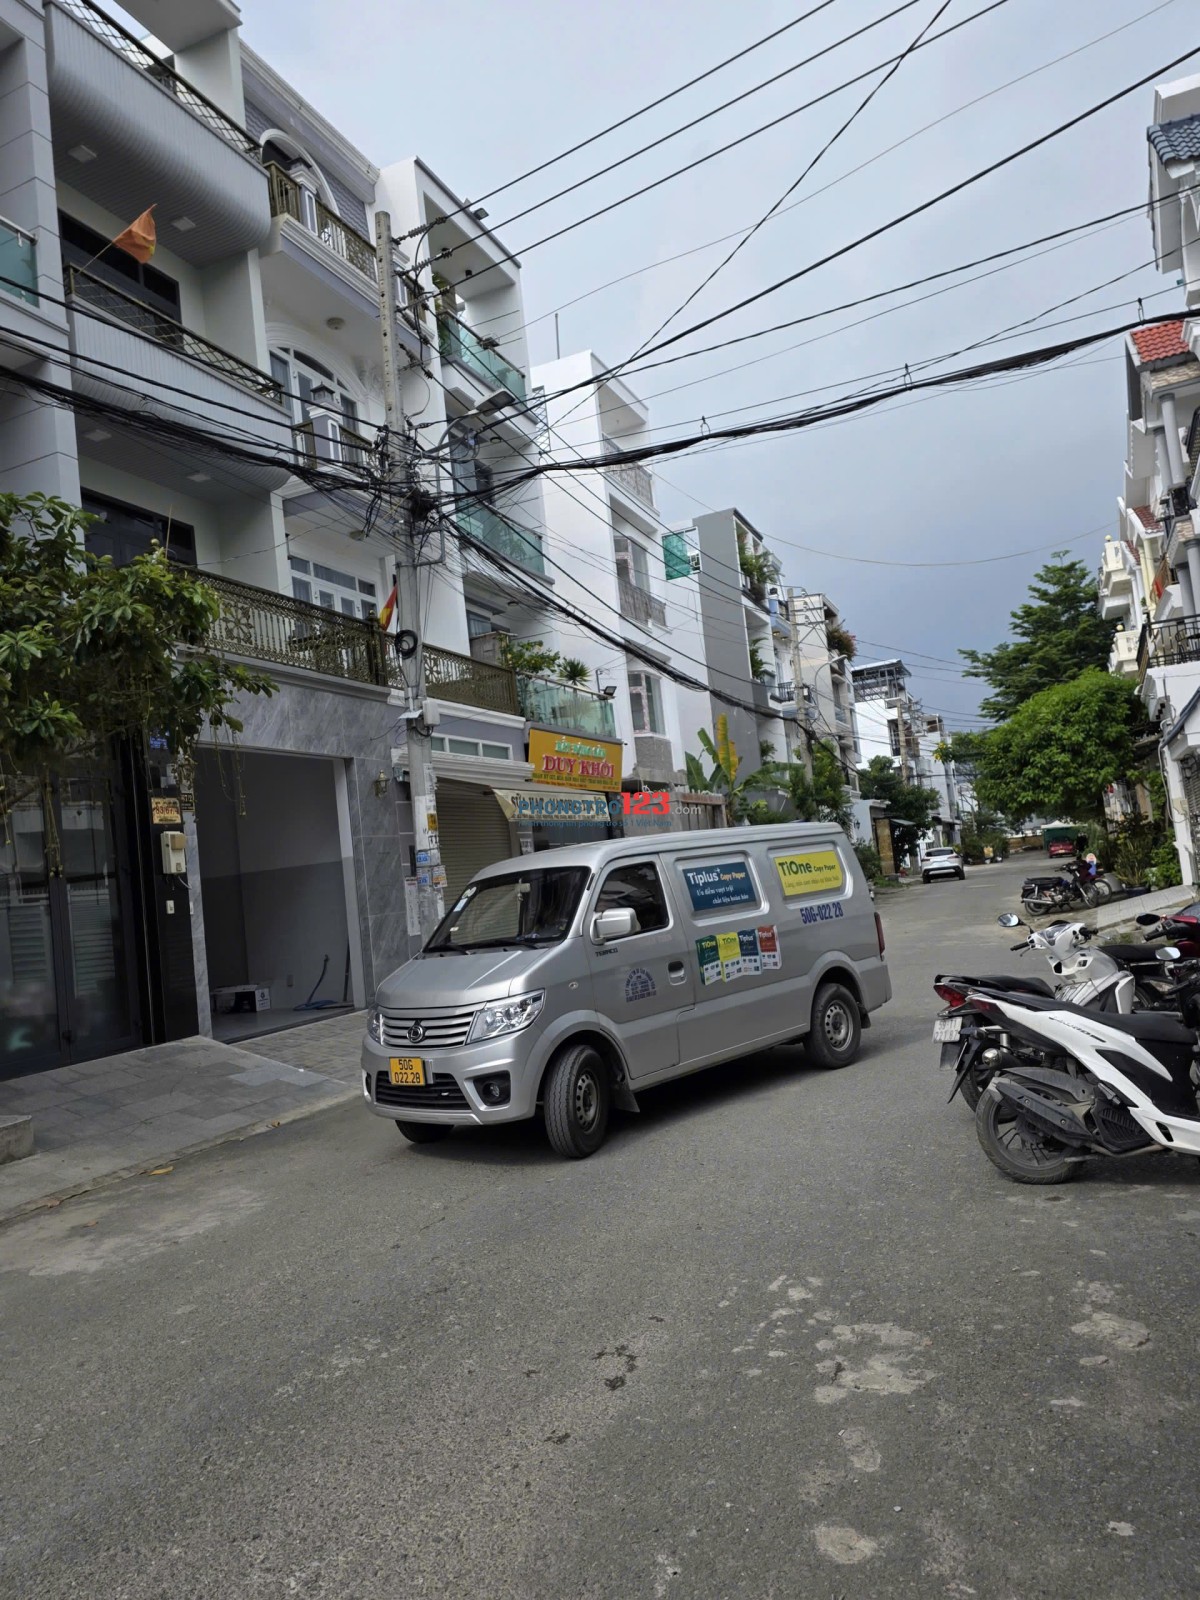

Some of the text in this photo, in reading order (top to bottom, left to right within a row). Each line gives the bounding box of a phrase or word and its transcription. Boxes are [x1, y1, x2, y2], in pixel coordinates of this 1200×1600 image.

[543, 754, 577, 773] DUY
[778, 860, 812, 876] TiOne
[800, 902, 844, 924] 50G-022 28
[398, 1059, 414, 1071] 50G
[394, 1071, 421, 1084] 022.28
